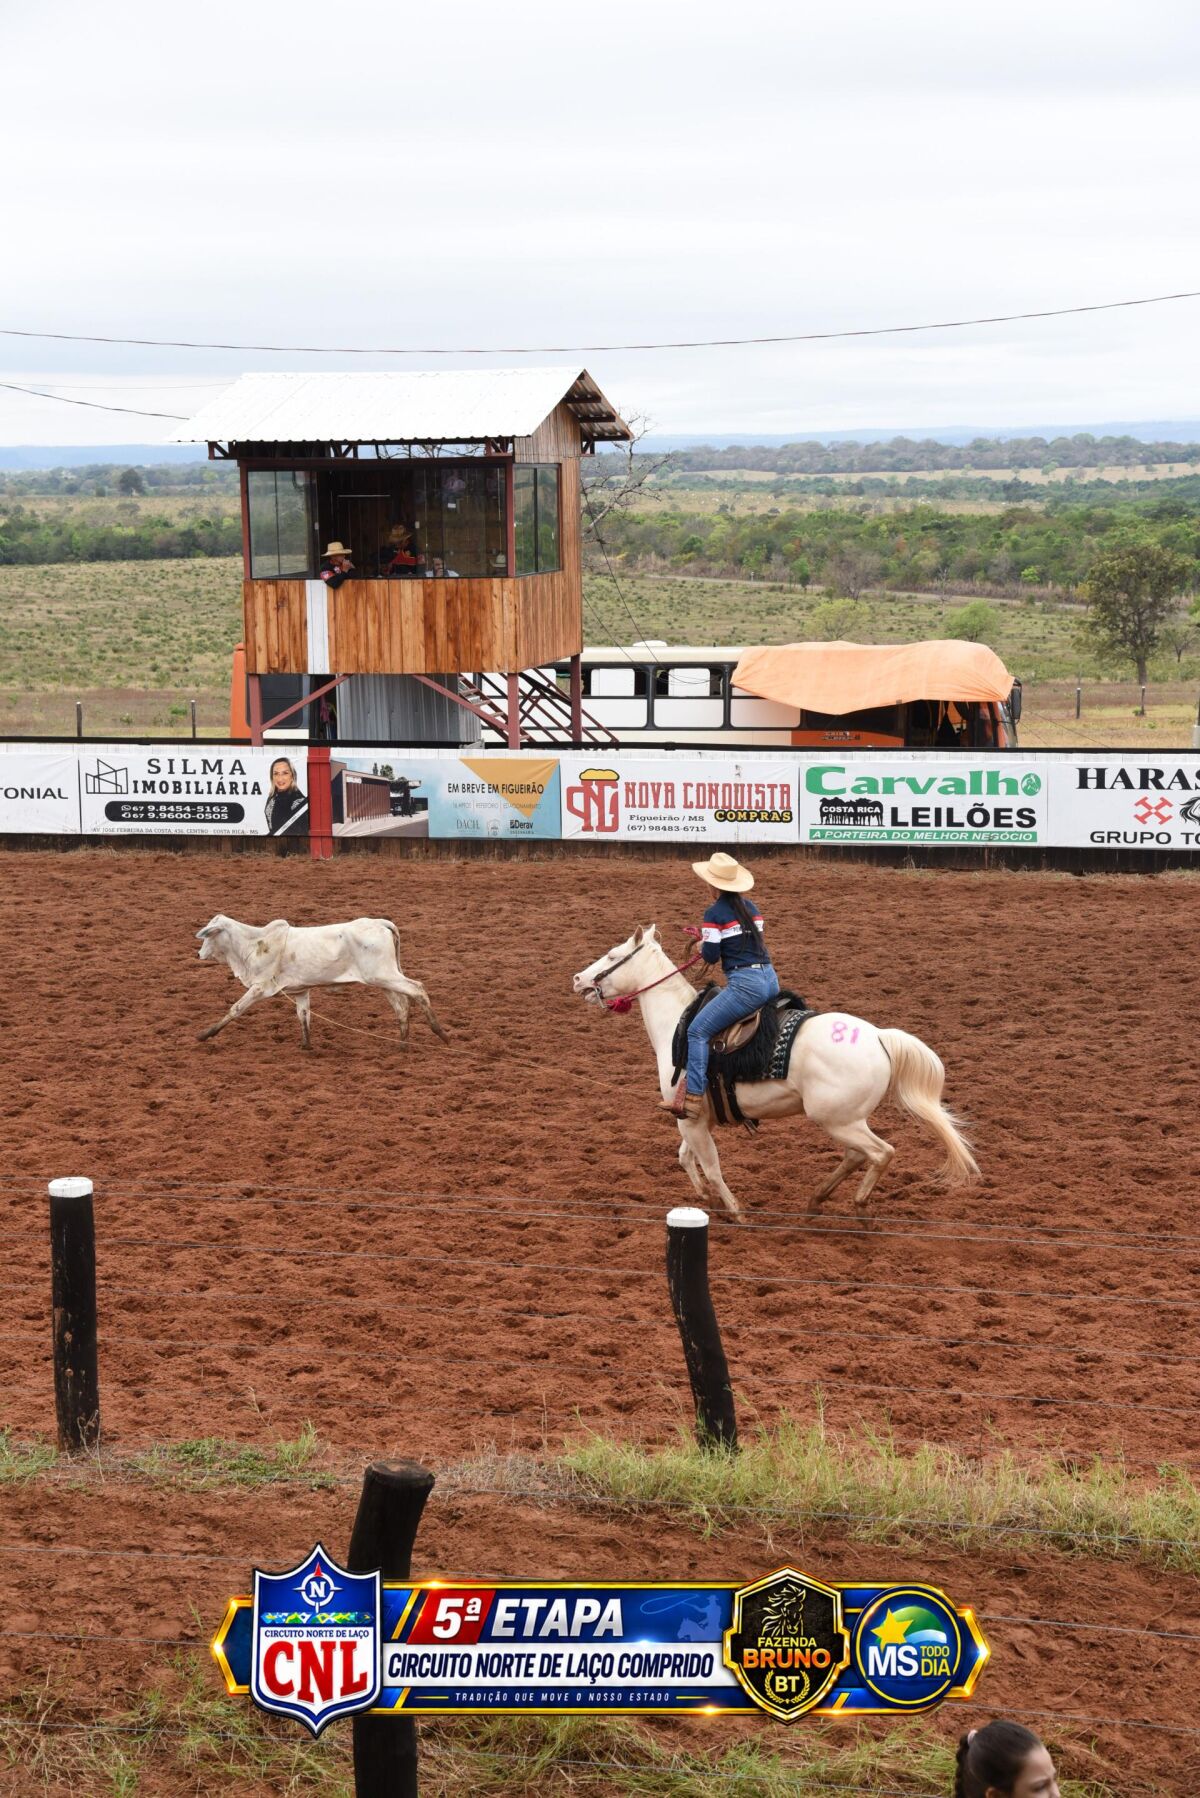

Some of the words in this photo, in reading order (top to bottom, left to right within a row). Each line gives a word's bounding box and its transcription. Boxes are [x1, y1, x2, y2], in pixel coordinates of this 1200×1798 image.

[147, 758, 247, 775] SILMA
[132, 776, 262, 796] IMOBILIÁRIA
[447, 783, 460, 794] EM
[461, 783, 486, 794] BREVE
[488, 783, 500, 794] EM
[501, 781, 544, 794] FIGUEIRÃO
[0, 787, 69, 800] ONIAL
[624, 781, 676, 809] NOVA
[682, 782, 792, 810] CONQUISTA
[147, 805, 228, 813] 9.8454-5162
[891, 802, 1037, 829] LEILÕES
[147, 812, 229, 820] 9.9600-0505
[629, 813, 680, 823] Figueirão
[715, 809, 793, 823] COMPRAS
[515, 819, 534, 829] Derav
[627, 824, 647, 832] (67)
[648, 824, 707, 832] 98483-6713
[812, 831, 822, 839] A
[824, 831, 888, 840] PORTEIRA
[891, 831, 911, 840] DO
[913, 831, 970, 841] MELHOR
[972, 830, 1033, 842] NEGÓCIO
[1089, 831, 1172, 845] GRUPO
[831, 1021, 860, 1045] 81
